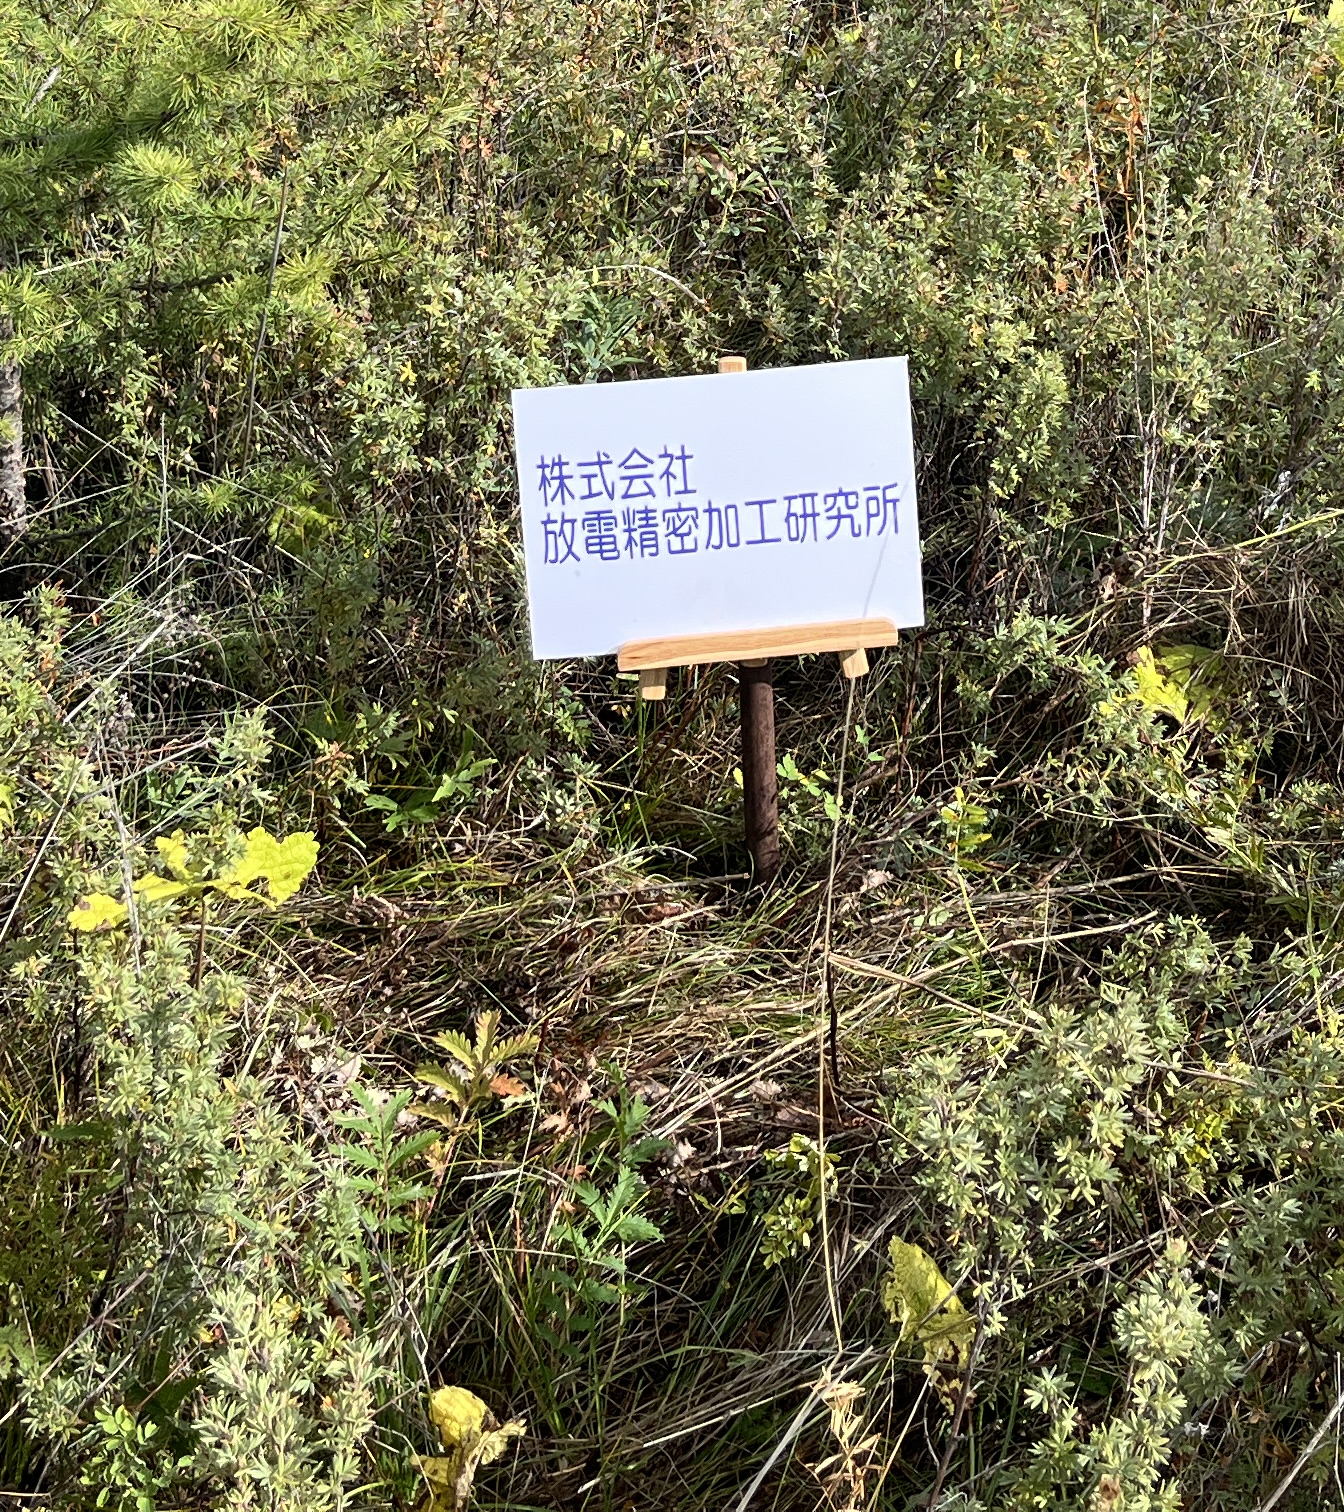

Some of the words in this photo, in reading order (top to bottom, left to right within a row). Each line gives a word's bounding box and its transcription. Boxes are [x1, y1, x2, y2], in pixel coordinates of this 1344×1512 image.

[535, 444, 697, 507] 株式会社
[540, 482, 901, 565] 放電精密加工研究所
